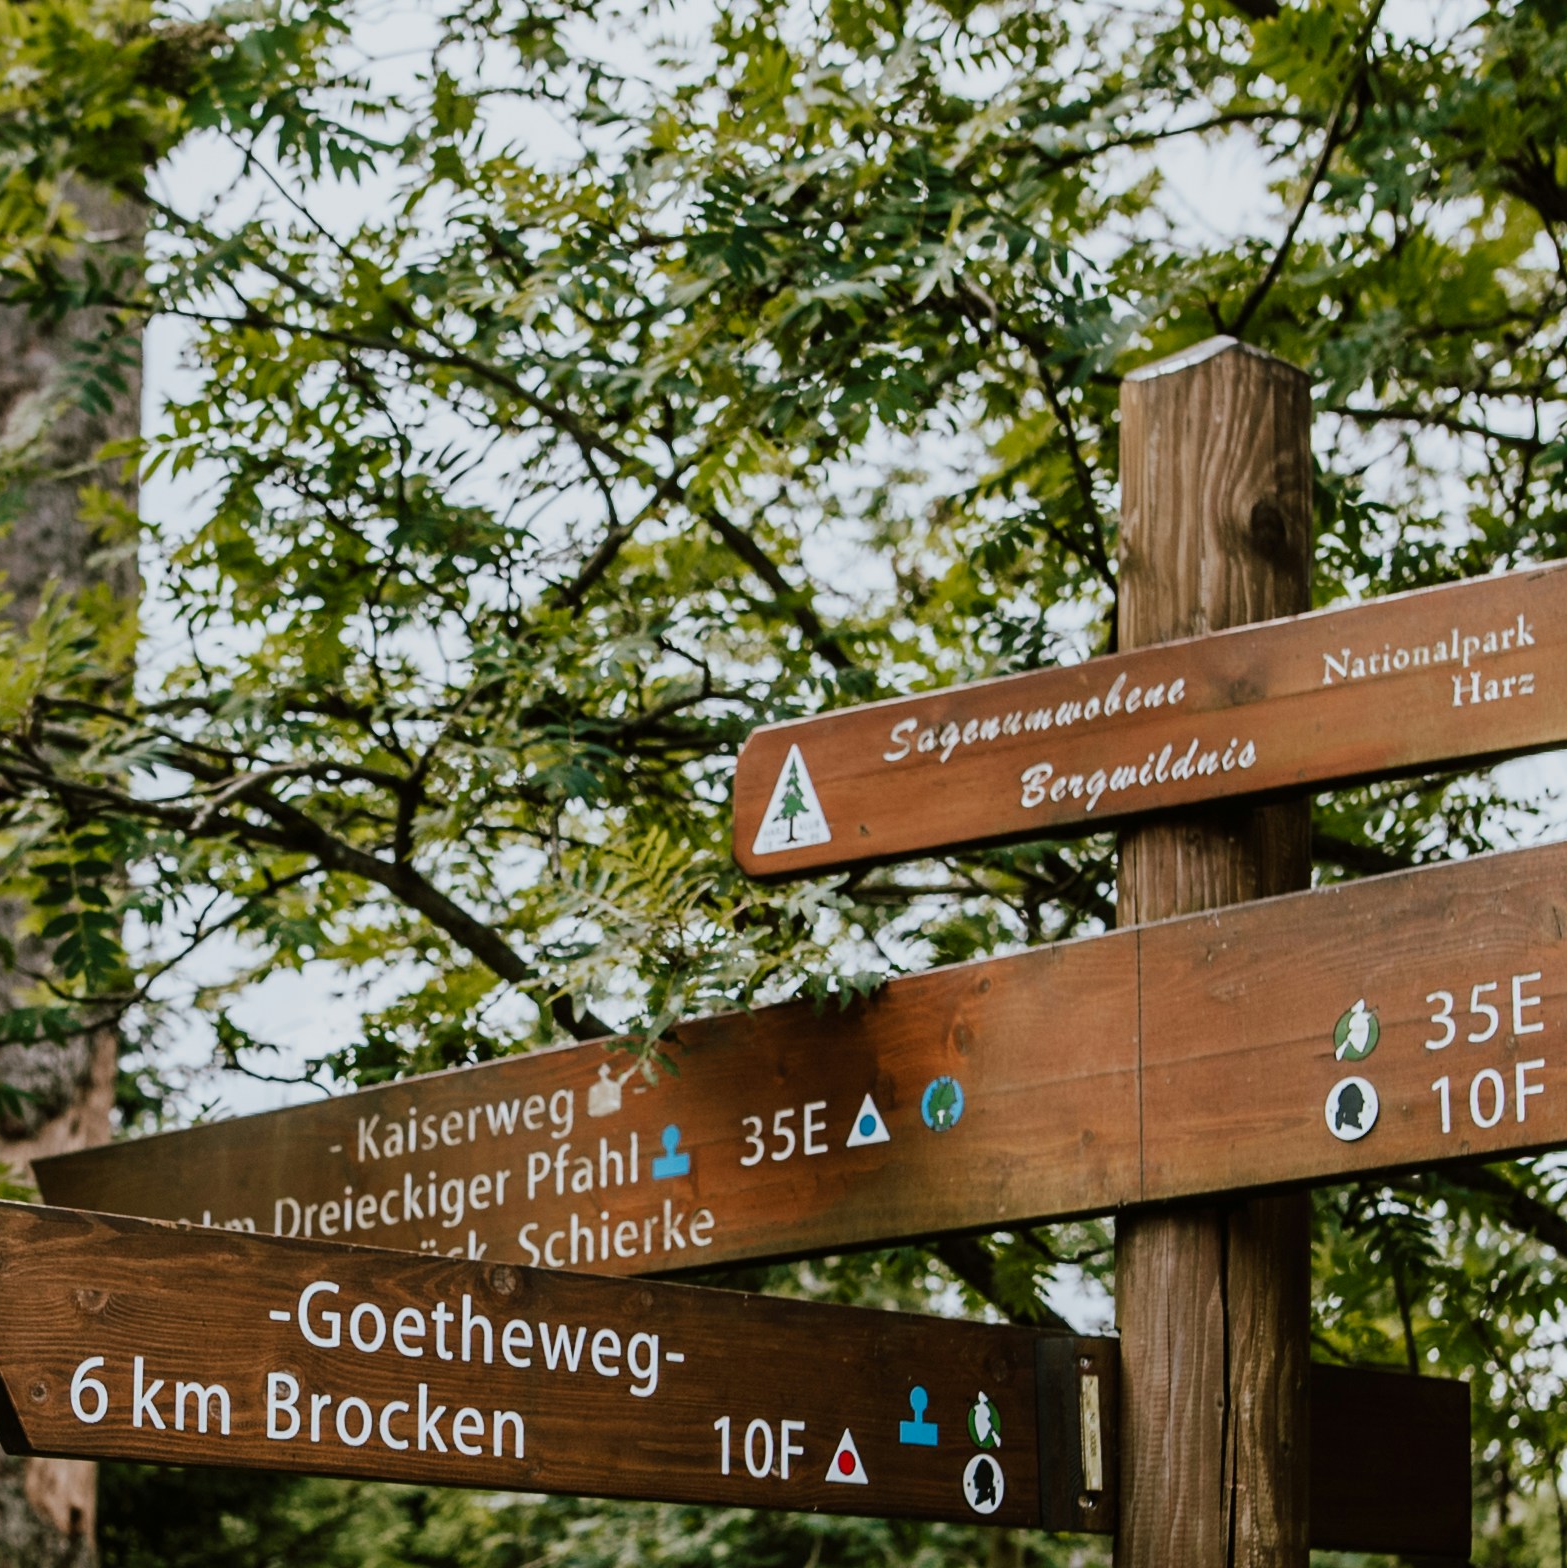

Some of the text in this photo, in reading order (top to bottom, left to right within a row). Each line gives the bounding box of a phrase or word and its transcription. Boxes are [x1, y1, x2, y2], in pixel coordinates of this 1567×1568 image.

[1322, 613, 1536, 686] Nationalpark
[883, 672, 1186, 763] Sagenumwobene
[1451, 671, 1536, 707] Harz
[1020, 737, 1257, 812] Bergwildnis
[1424, 970, 1545, 1052] 35E
[357, 1088, 575, 1161] Kaiserweg
[1431, 1057, 1546, 1134] 10F
[273, 1101, 829, 1238] Dreieckiger Pfahl 35E
[517, 1199, 715, 1269] Schierke
[69, 1355, 806, 1481] 6 km Brocken 10F
